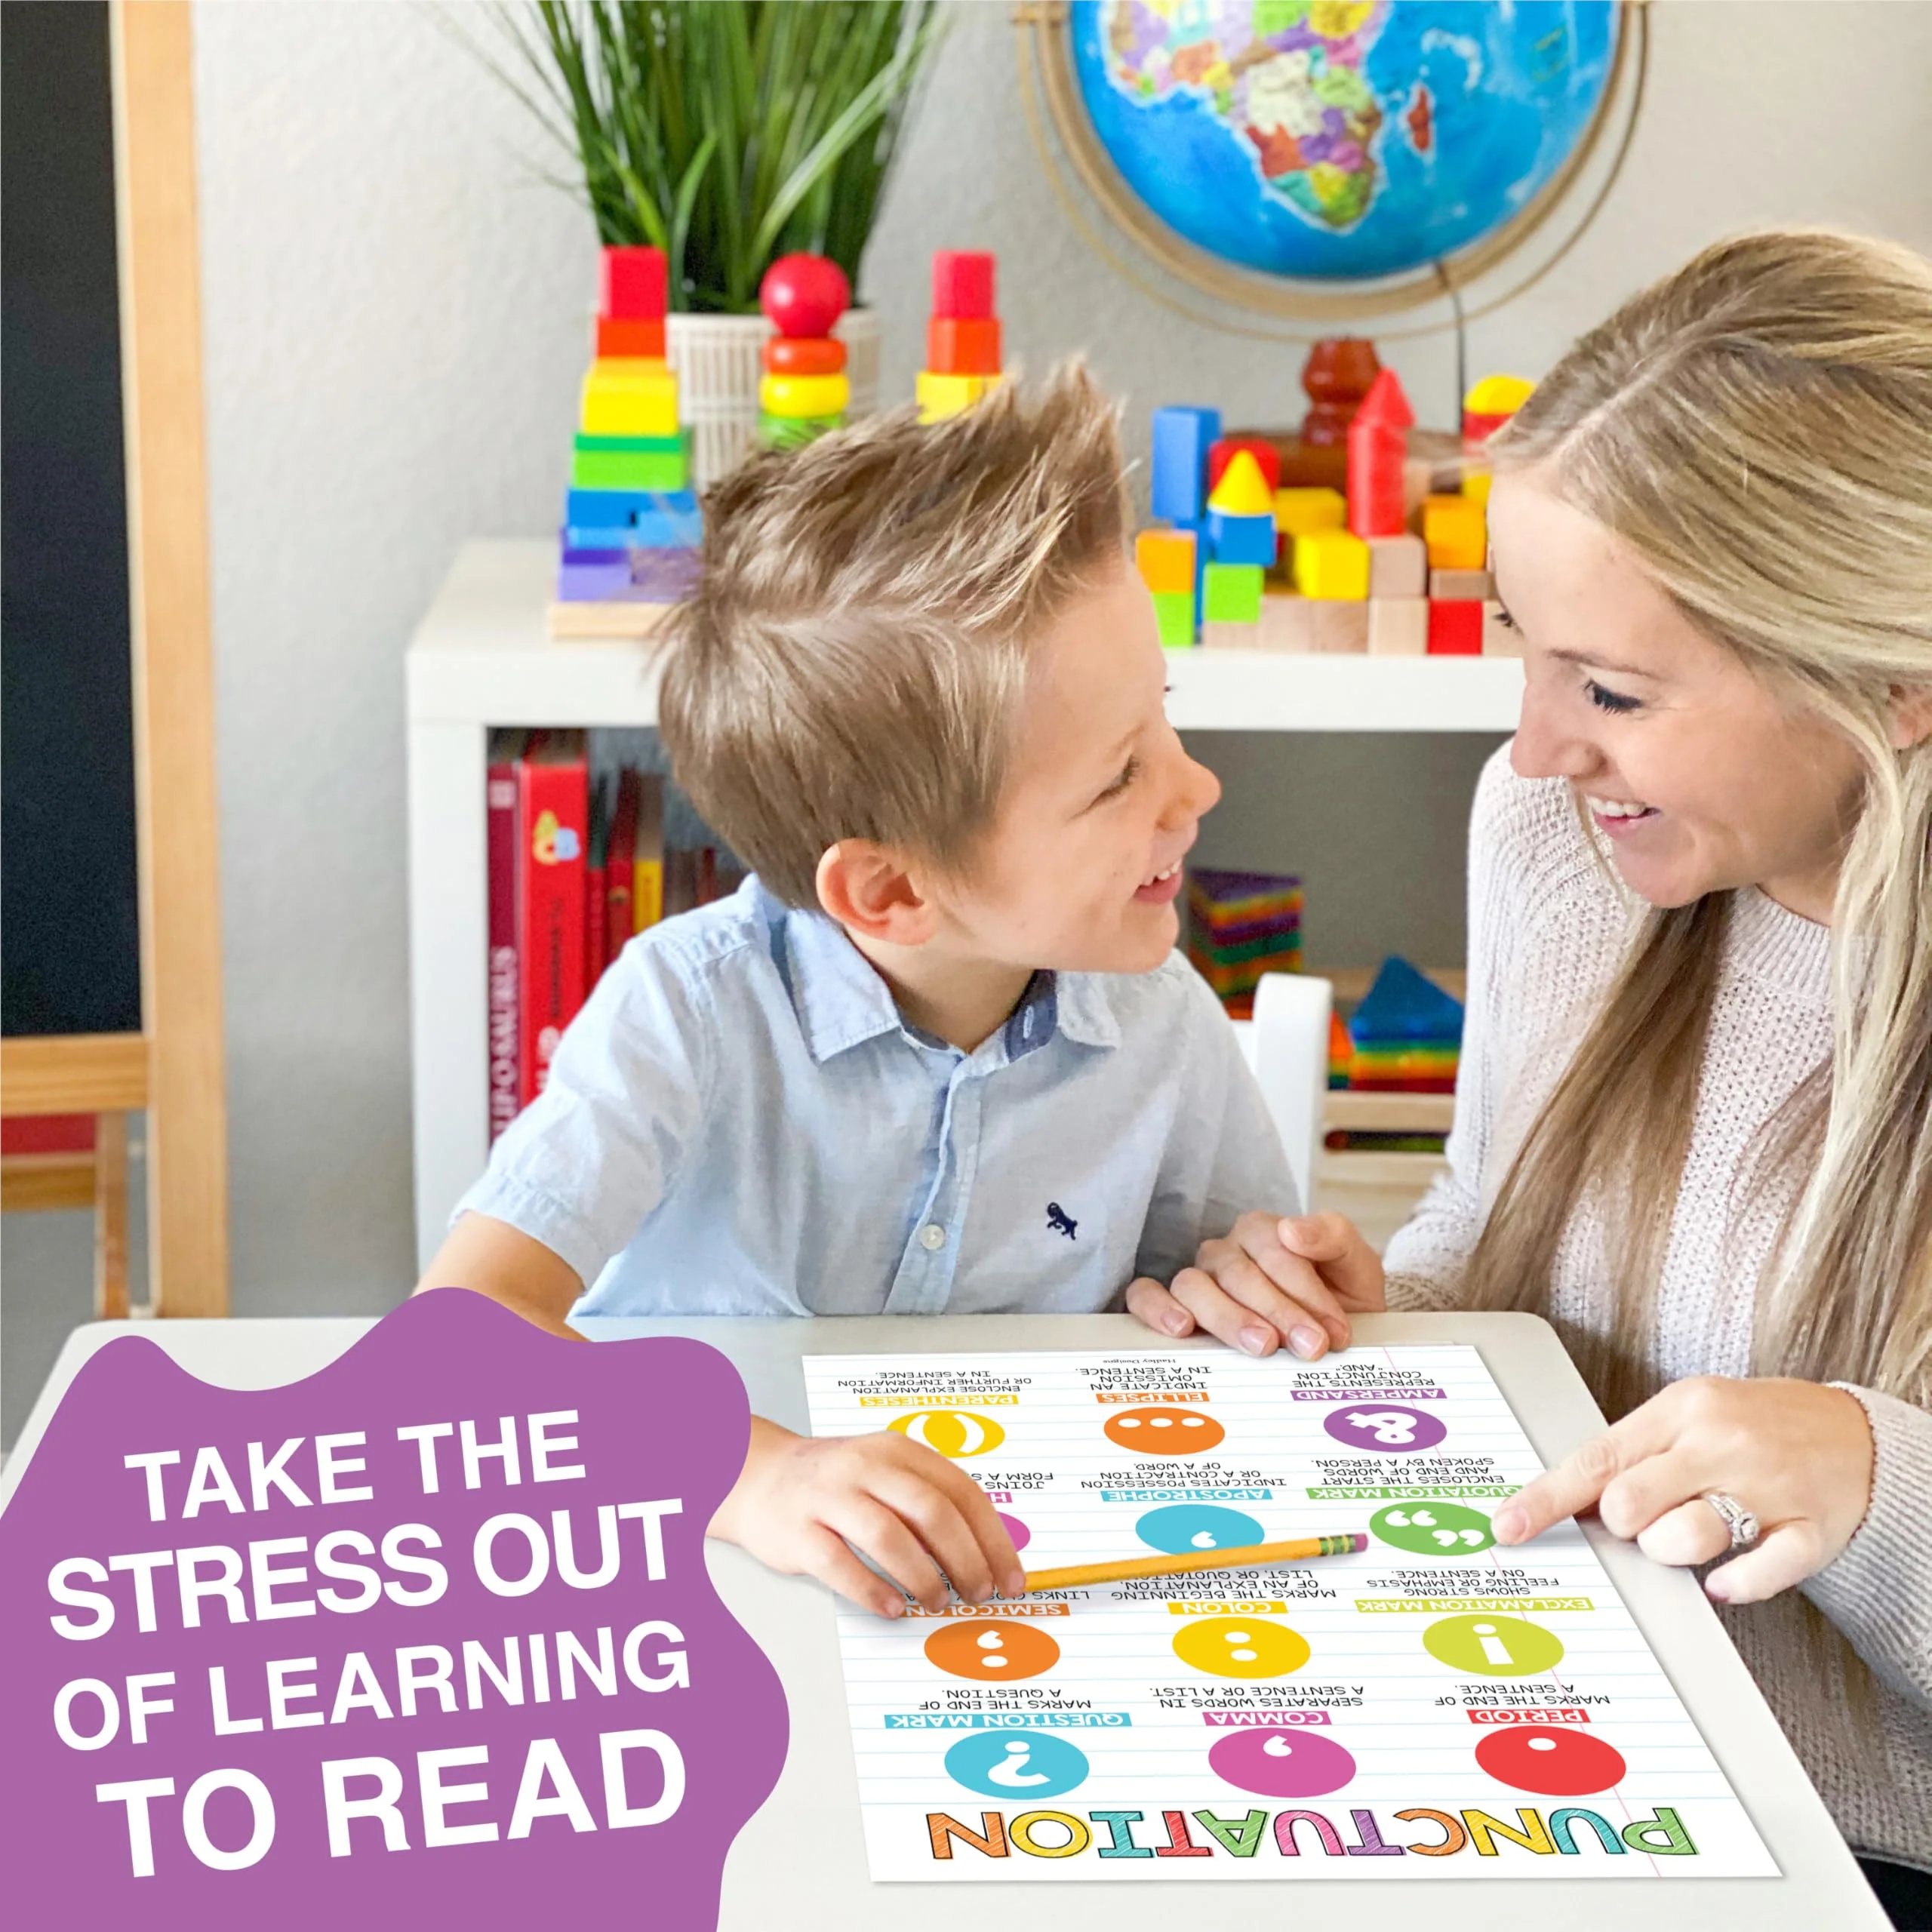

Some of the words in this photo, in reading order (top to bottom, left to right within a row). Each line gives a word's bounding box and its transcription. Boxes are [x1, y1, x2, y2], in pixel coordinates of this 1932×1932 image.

[1075, 1367, 1166, 1376] SENTENCE.
[1188, 1366, 1212, 1374] IN
[1100, 1374, 1192, 1383] OMISSION
[1297, 1371, 1422, 1380] CONJUNCTION
[838, 1379, 943, 1387] INFORMATION
[1120, 1382, 1208, 1390] INDICATE
[1329, 1378, 1435, 1387] REPRESENTS
[851, 1386, 955, 1394] EXPLANATION
[1296, 1389, 1439, 1400] AMPERSAND
[861, 1395, 1014, 1405] PARENTHESES
[1100, 1392, 1204, 1402] ELLIPSES
[1202, 1462, 1221, 1470] OF
[1311, 1459, 1382, 1468] PERSON.
[1386, 1459, 1398, 1467] A
[1406, 1458, 1424, 1466] BY
[1429, 1457, 1494, 1466] SPOKEN
[1134, 1463, 1180, 1471] WORD.
[1390, 1467, 1410, 1475] OF
[1415, 1466, 1450, 1475] END
[1454, 1466, 1489, 1475] AND
[988, 1472, 1000, 1481] A
[1006, 1472, 1054, 1481] FORM
[1100, 1471, 1218, 1480] CONTRACTION
[1323, 1468, 1384, 1476] WORDS
[1192, 1478, 1287, 1487] INDICATES
[1321, 1477, 1375, 1485] START
[1380, 1476, 1414, 1485] THE
[1417, 1475, 1505, 1484] ENCLOSES
[984, 1481, 1044, 1490] JOINS
[1081, 1480, 1186, 1489] POSSESSION
[1107, 1489, 1266, 1500] APOSTROPHE
[1312, 1487, 1381, 1500] MARK
[1388, 1485, 1520, 1498] QUOTATION
[1121, 1571, 1231, 1580] QUOTAT
[1235, 1570, 1260, 1580] OR
[1392, 1570, 1481, 1579] SENTENCE.
[1502, 1569, 1525, 1577] ON
[1263, 1580, 1288, 1589] AN
[1297, 1580, 1319, 1589] OF
[1367, 1579, 1456, 1588] EMPHASIS
[1459, 1579, 1481, 1587] OR
[1485, 1578, 1559, 1586] FEELING
[1032, 1591, 1090, 1600] LINKS
[1111, 1590, 1226, 1601] BEGINNING
[1231, 1590, 1267, 1599] THE
[1271, 1589, 1337, 1598] MARKS
[1404, 1588, 1469, 1596] STRONG
[1474, 1587, 1531, 1595] SHOWS
[1182, 1602, 1272, 1614] COLON
[1357, 1600, 1426, 1612] MARK
[1429, 1598, 1589, 1611] EXCLAMATION
[1048, 1689, 1061, 1698] A
[1150, 1687, 1198, 1697] LIST.
[1202, 1687, 1214, 1697] A
[1221, 1687, 1245, 1697] OR
[1250, 1686, 1346, 1696] SENTENCE
[1351, 1686, 1364, 1695] A
[1454, 1684, 1557, 1694] SENTENCE.
[1561, 1684, 1574, 1694] A
[942, 1689, 1044, 1699] QUESTION.
[946, 1700, 982, 1709] END
[987, 1700, 1023, 1709] THE
[1027, 1700, 1091, 1709] MARKS
[1159, 1699, 1186, 1709] IN
[1191, 1698, 1254, 1708] WORDS
[1259, 1697, 1363, 1707] SEPARATES
[1435, 1697, 1457, 1706] OF
[1462, 1696, 1500, 1706] END
[1503, 1696, 1540, 1706] THE
[1543, 1695, 1611, 1705] MARKS
[918, 1701, 940, 1710] OF
[980, 1712, 1124, 1727] QUESTION
[1207, 1712, 1324, 1725] COMMA
[1474, 1709, 1583, 1723] PERIOD
[891, 1715, 974, 1728] MARK
[926, 1807, 1700, 1858] PUNCTUATION
